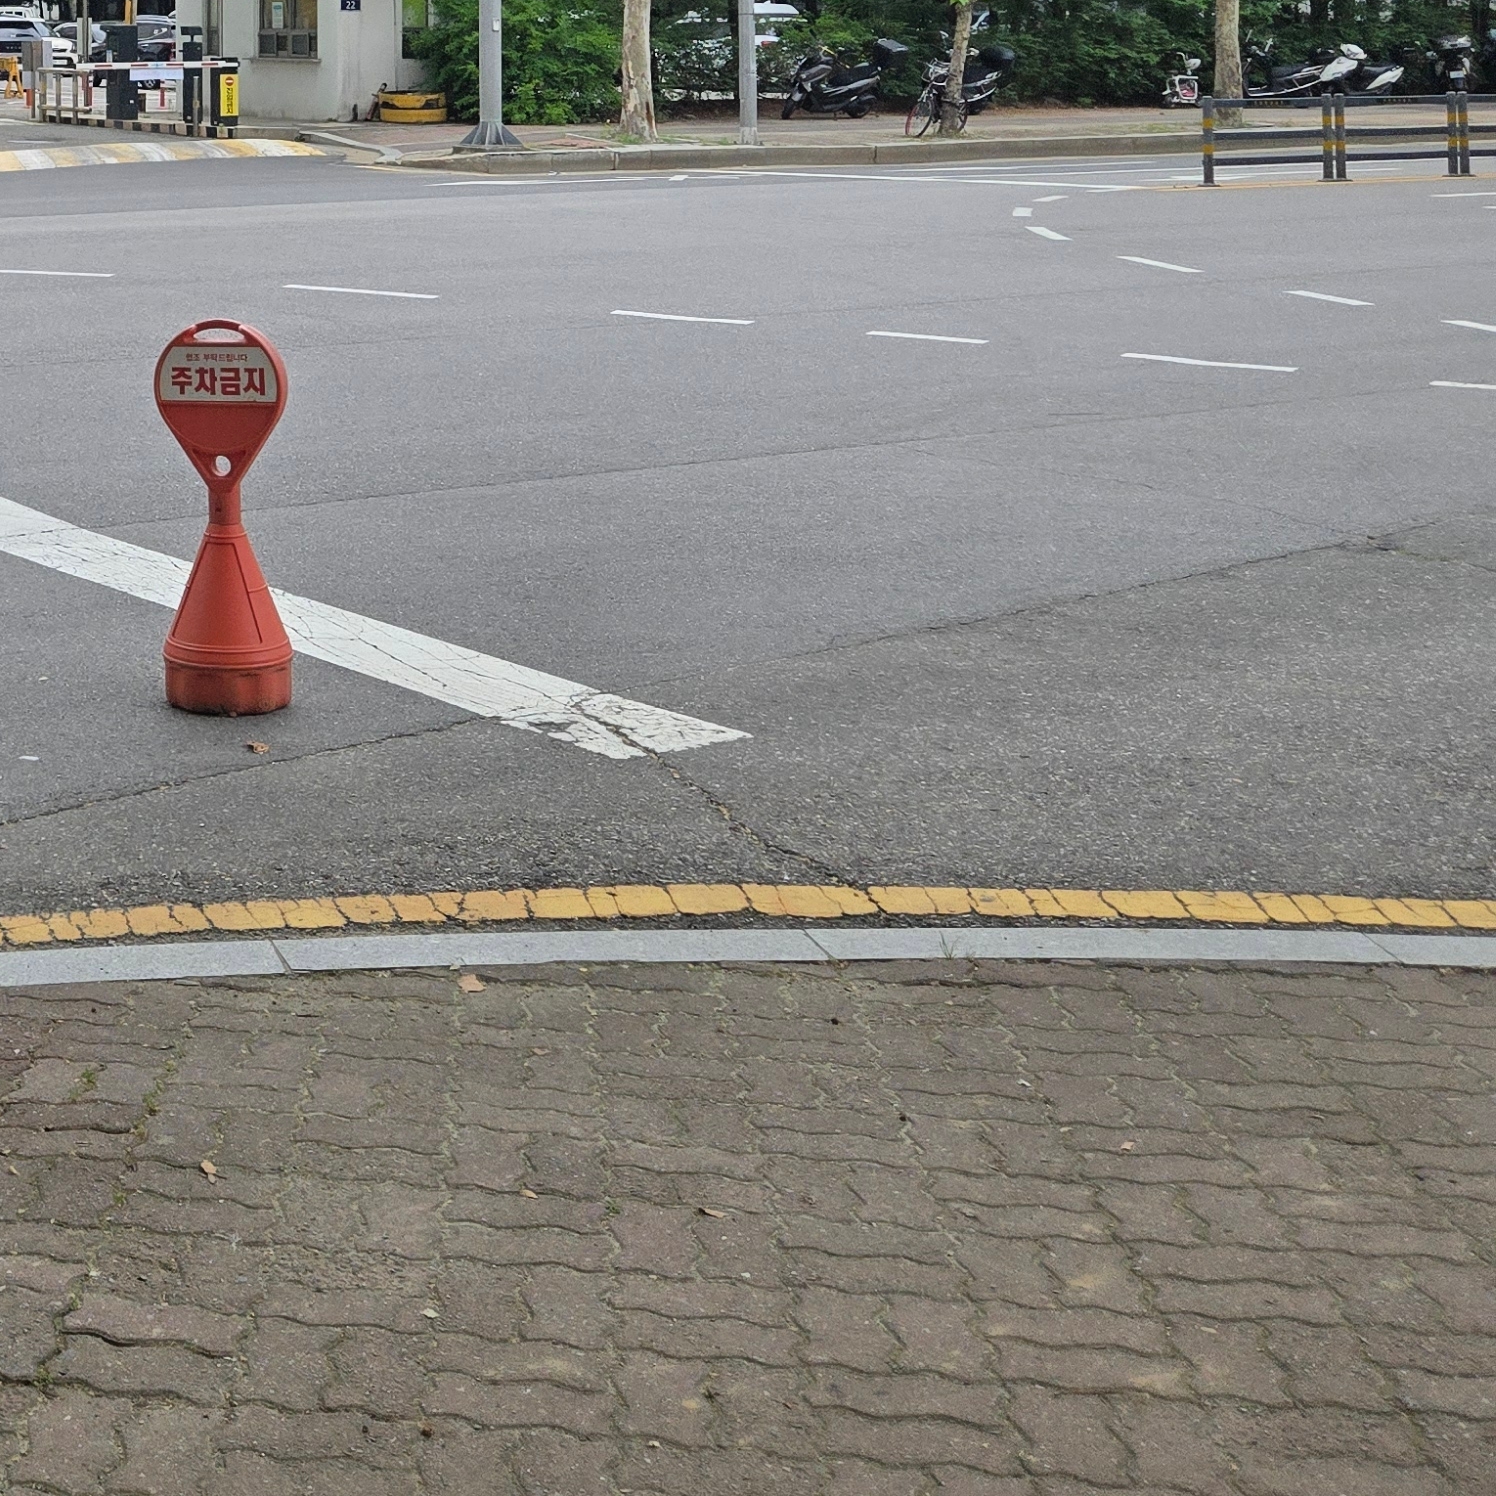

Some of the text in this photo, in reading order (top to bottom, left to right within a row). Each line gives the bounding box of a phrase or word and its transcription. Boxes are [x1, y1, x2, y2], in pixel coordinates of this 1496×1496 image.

[345, 0, 356, 10] 22
[203, 353, 248, 362] 부탁드립니다
[171, 366, 266, 396] 주차금지
